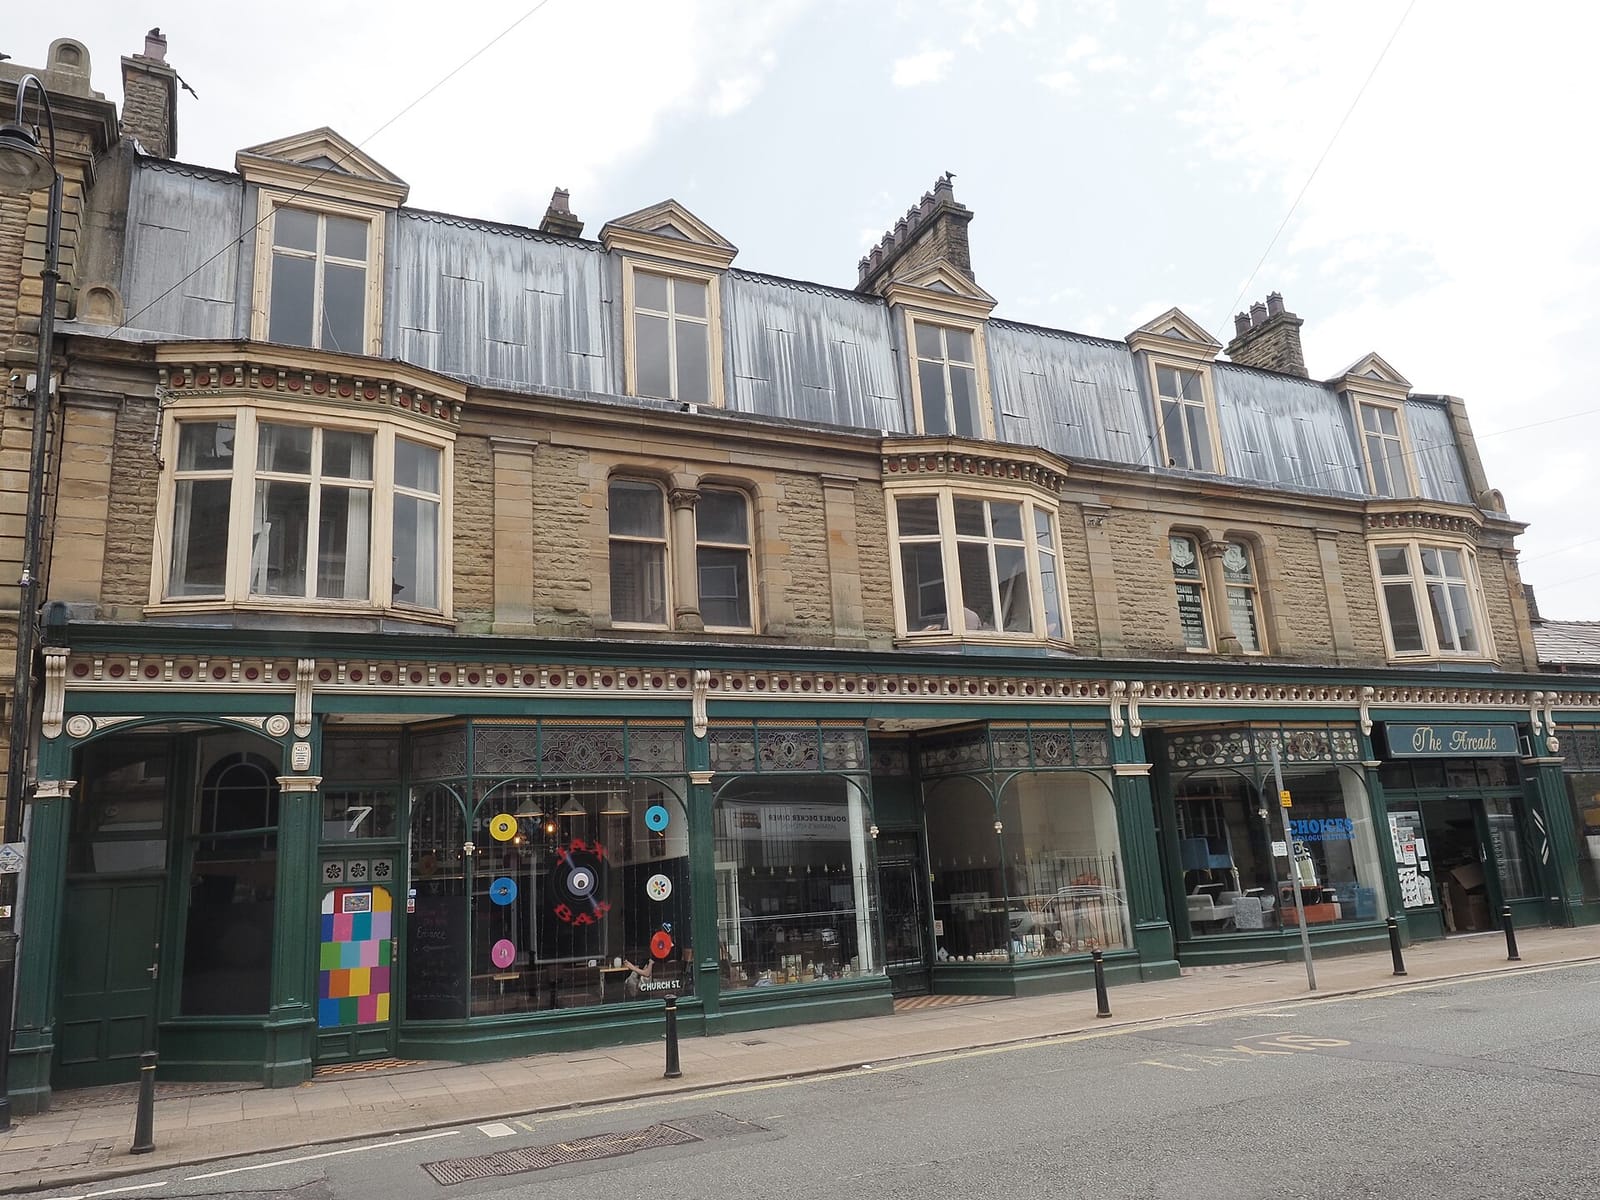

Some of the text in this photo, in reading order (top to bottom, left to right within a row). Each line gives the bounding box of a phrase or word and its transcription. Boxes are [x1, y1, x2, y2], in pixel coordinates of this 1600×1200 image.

[1412, 726, 1497, 752] The Arcade
[347, 806, 373, 832] 7
[1289, 817, 1354, 834] CHOICES
[554, 901, 612, 926] BAR
[640, 981, 671, 991] CHURCH
